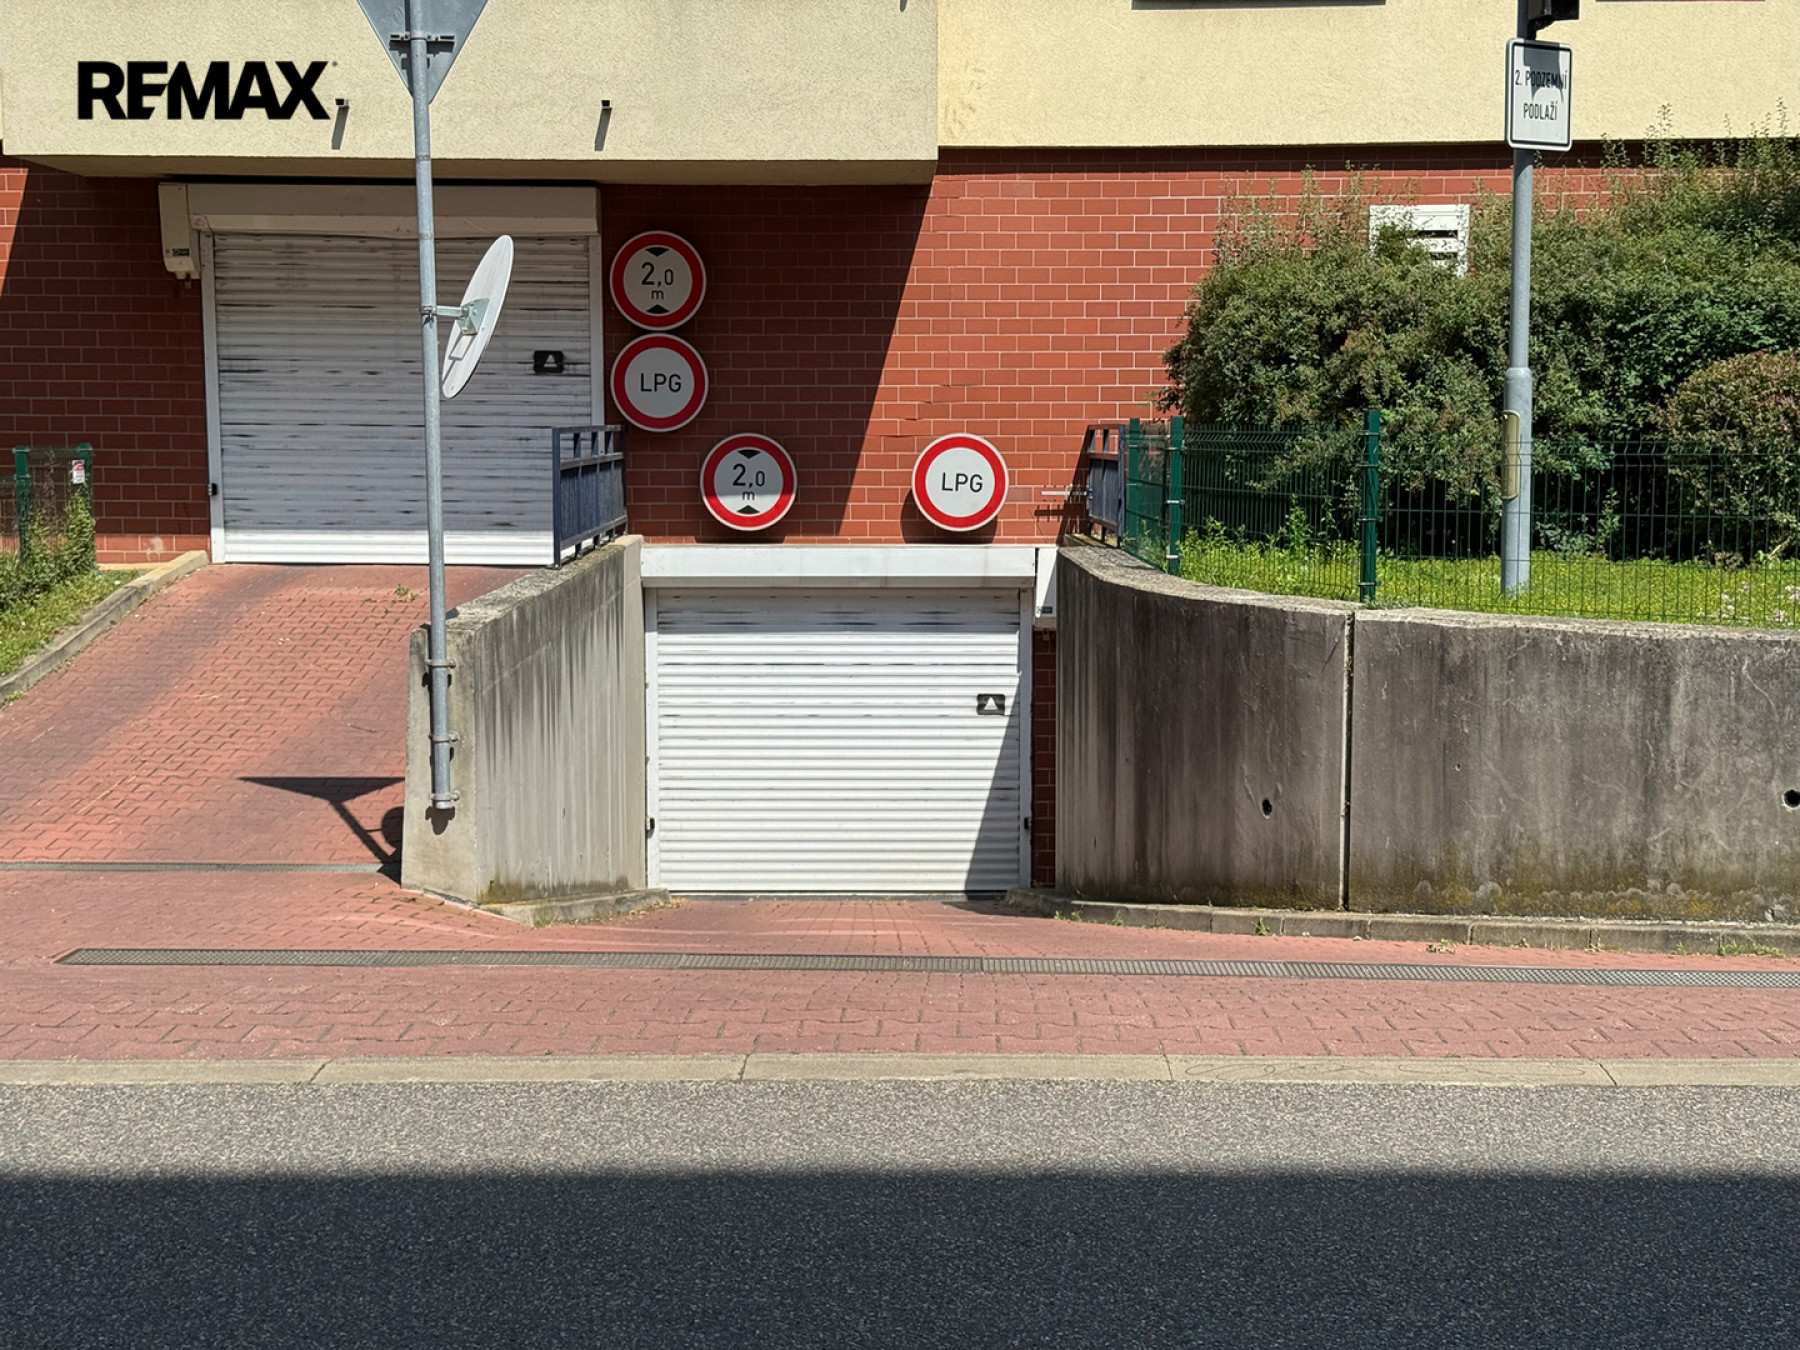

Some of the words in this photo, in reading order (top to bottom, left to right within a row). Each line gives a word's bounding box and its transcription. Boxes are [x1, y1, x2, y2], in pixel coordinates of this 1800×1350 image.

[1515, 70, 1522, 85] 2.
[1525, 70, 1568, 90] PODZEMNÍ
[1523, 101, 1558, 120] PODLAŽÍ
[640, 261, 674, 288] 2,0
[651, 289, 664, 300] m
[640, 373, 682, 393] LPG
[732, 463, 766, 488] 2,0
[941, 472, 984, 493] LPG
[742, 490, 755, 501] m
